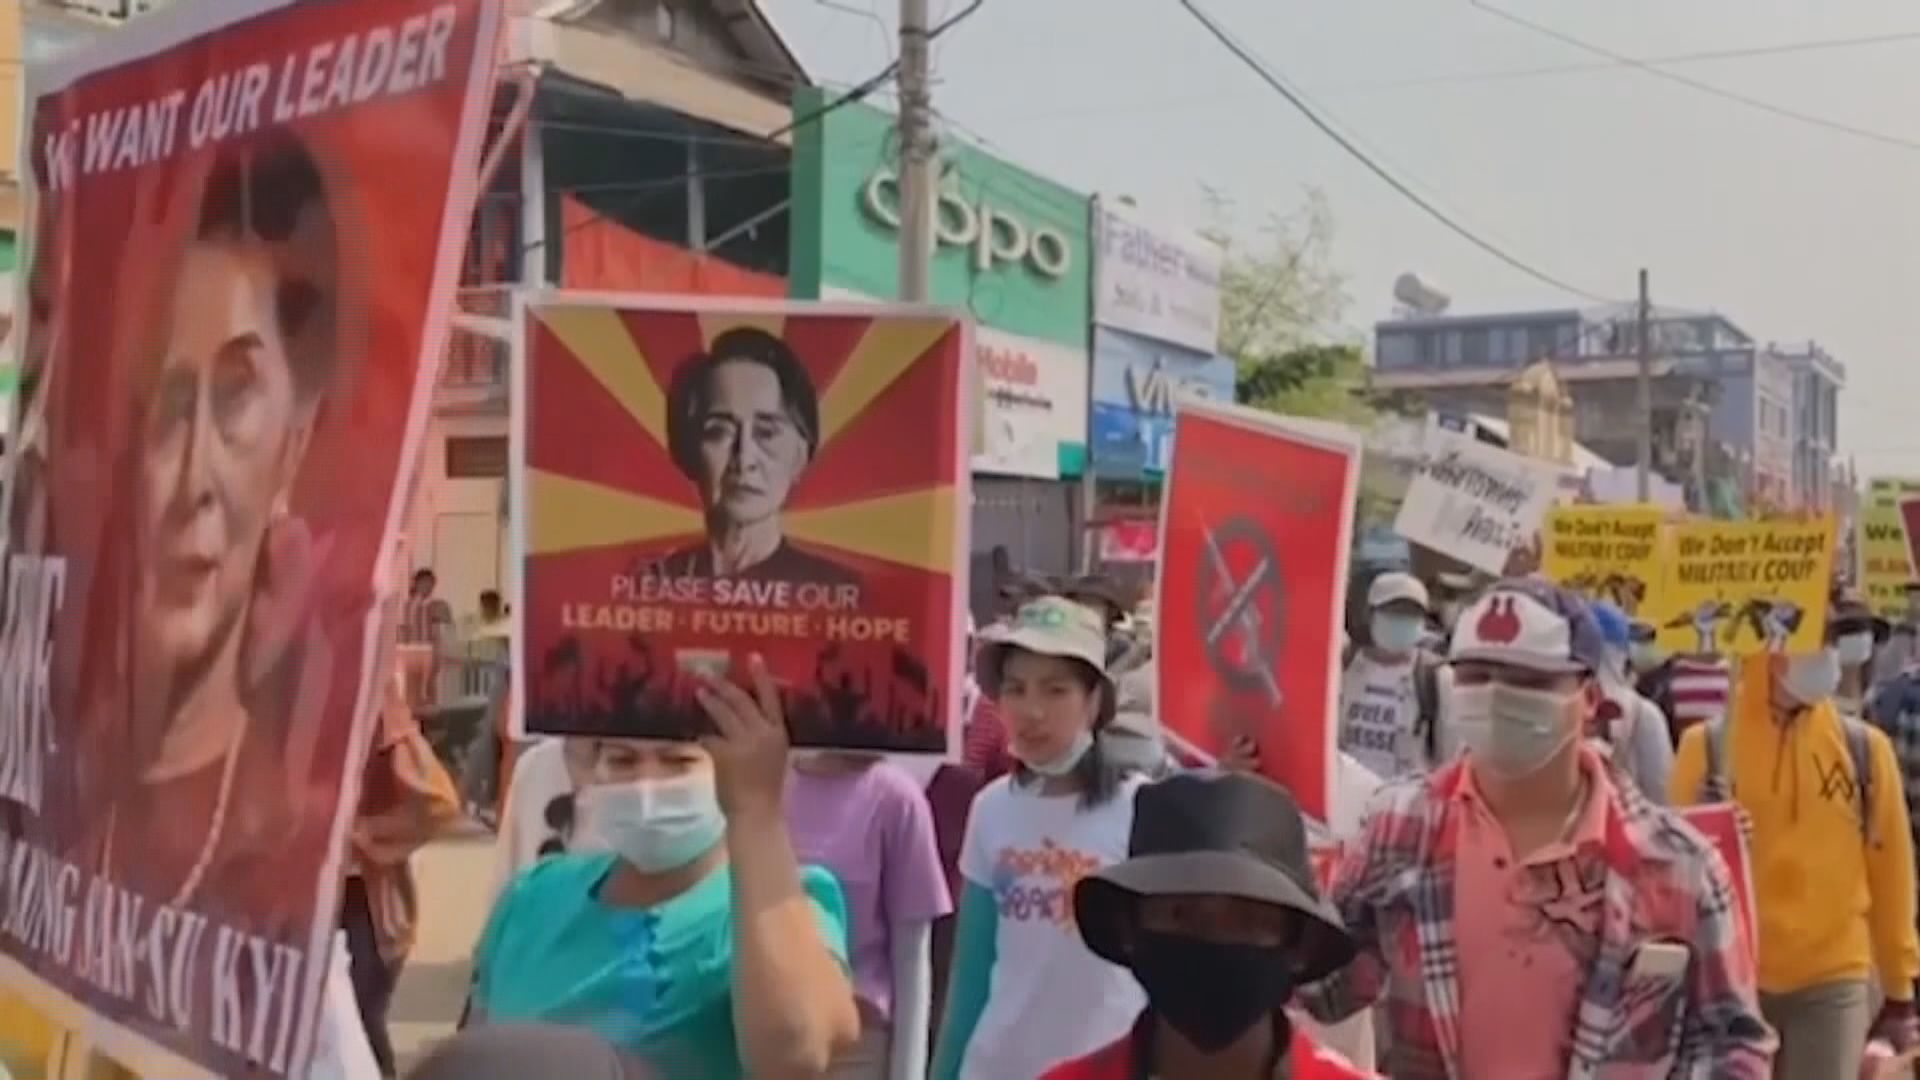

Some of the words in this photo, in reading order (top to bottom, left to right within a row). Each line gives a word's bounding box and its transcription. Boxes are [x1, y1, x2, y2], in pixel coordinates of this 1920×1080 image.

[83, 90, 187, 173] WANT
[190, 65, 270, 147] OUR
[273, 5, 456, 122] LEADER
[1763, 530, 1825, 557] Accept
[610, 574, 705, 604] PLEASE
[712, 580, 791, 606] SAVE
[797, 582, 860, 611] OUR
[562, 603, 673, 632] LEADER
[692, 608, 808, 637] FUTURE
[826, 616, 911, 643] HOPE
